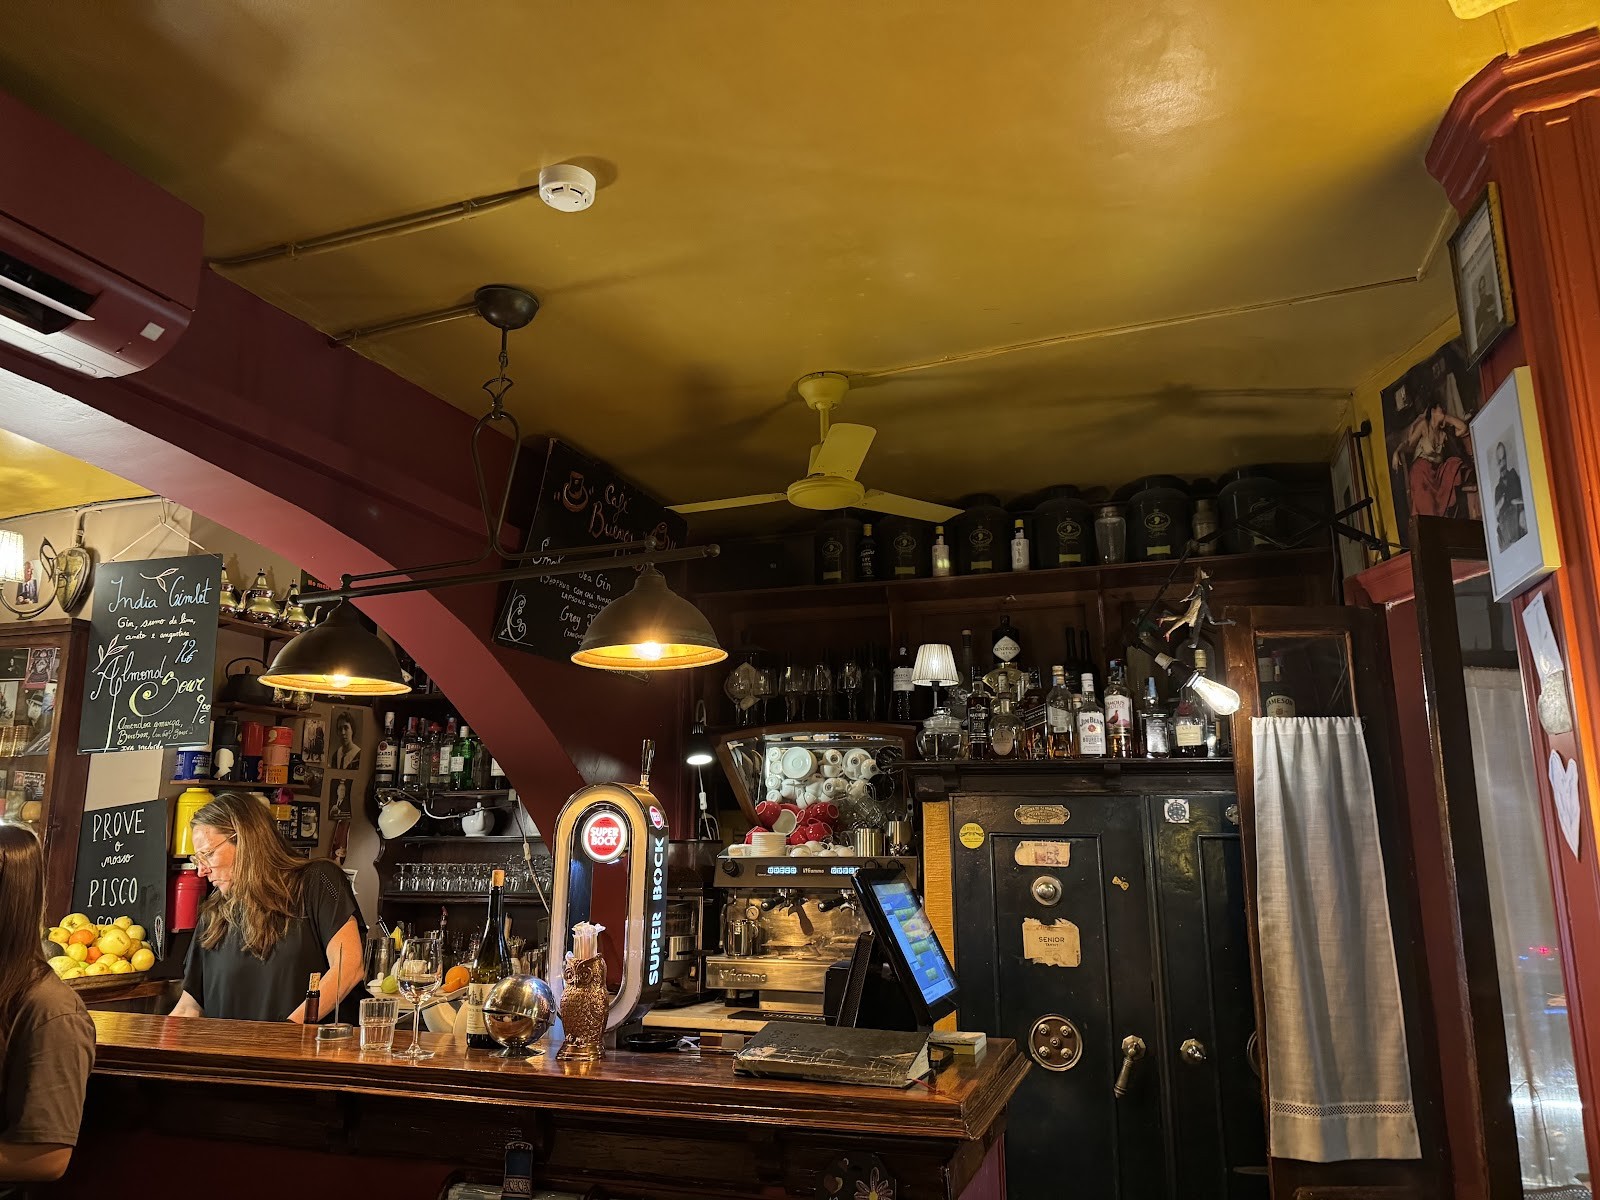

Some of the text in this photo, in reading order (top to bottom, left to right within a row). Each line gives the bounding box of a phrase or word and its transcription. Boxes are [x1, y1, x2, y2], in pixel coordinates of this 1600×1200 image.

[595, 573, 611, 592] Gin
[108, 575, 212, 613] India Gimlet
[117, 616, 139, 630] Gin,
[90, 651, 167, 700] Almond
[1080, 718, 1090, 727] JIM
[92, 808, 146, 842] PROVE
[590, 826, 619, 837] SUPER
[114, 841, 124, 852] o
[591, 836, 617, 846] BOCK
[101, 854, 134, 868] nosso
[652, 836, 665, 900] BOCK
[87, 877, 138, 908] PISCO
[648, 912, 662, 986] SUPER
